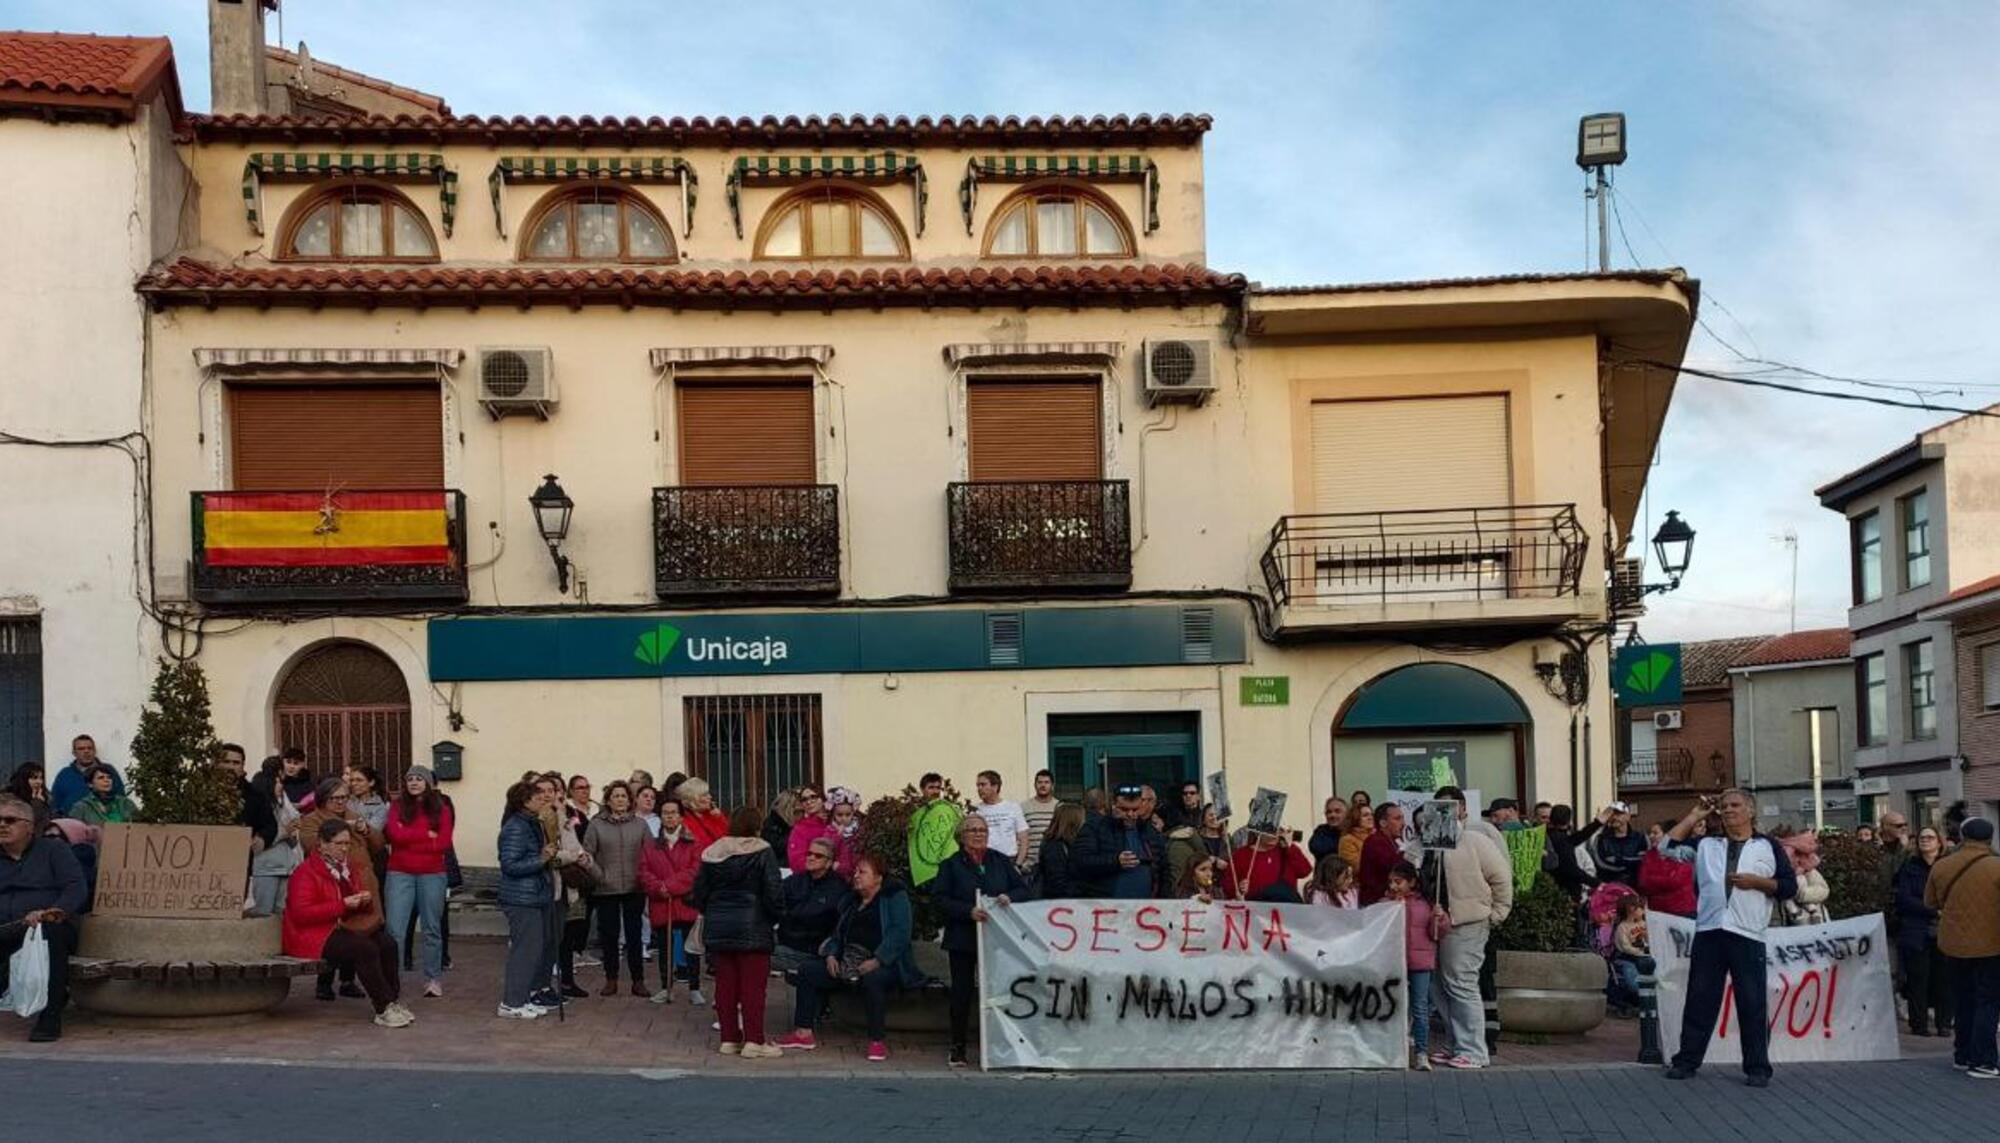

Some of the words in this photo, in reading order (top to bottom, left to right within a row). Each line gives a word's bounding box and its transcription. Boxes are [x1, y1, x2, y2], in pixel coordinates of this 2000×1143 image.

[687, 636, 787, 666] Unicaja
[101, 869, 111, 890] A
[116, 870, 136, 890] LA
[142, 872, 202, 891] PLANTA
[96, 892, 158, 910] ASFALTO
[164, 893, 186, 910] EN
[1047, 904, 1292, 953] SESEÑA
[1775, 935, 1870, 964] ASFALTO
[1004, 975, 1090, 1021] SIN
[1118, 973, 1256, 1021] MALOS
[1280, 977, 1400, 1022] HUMOS
